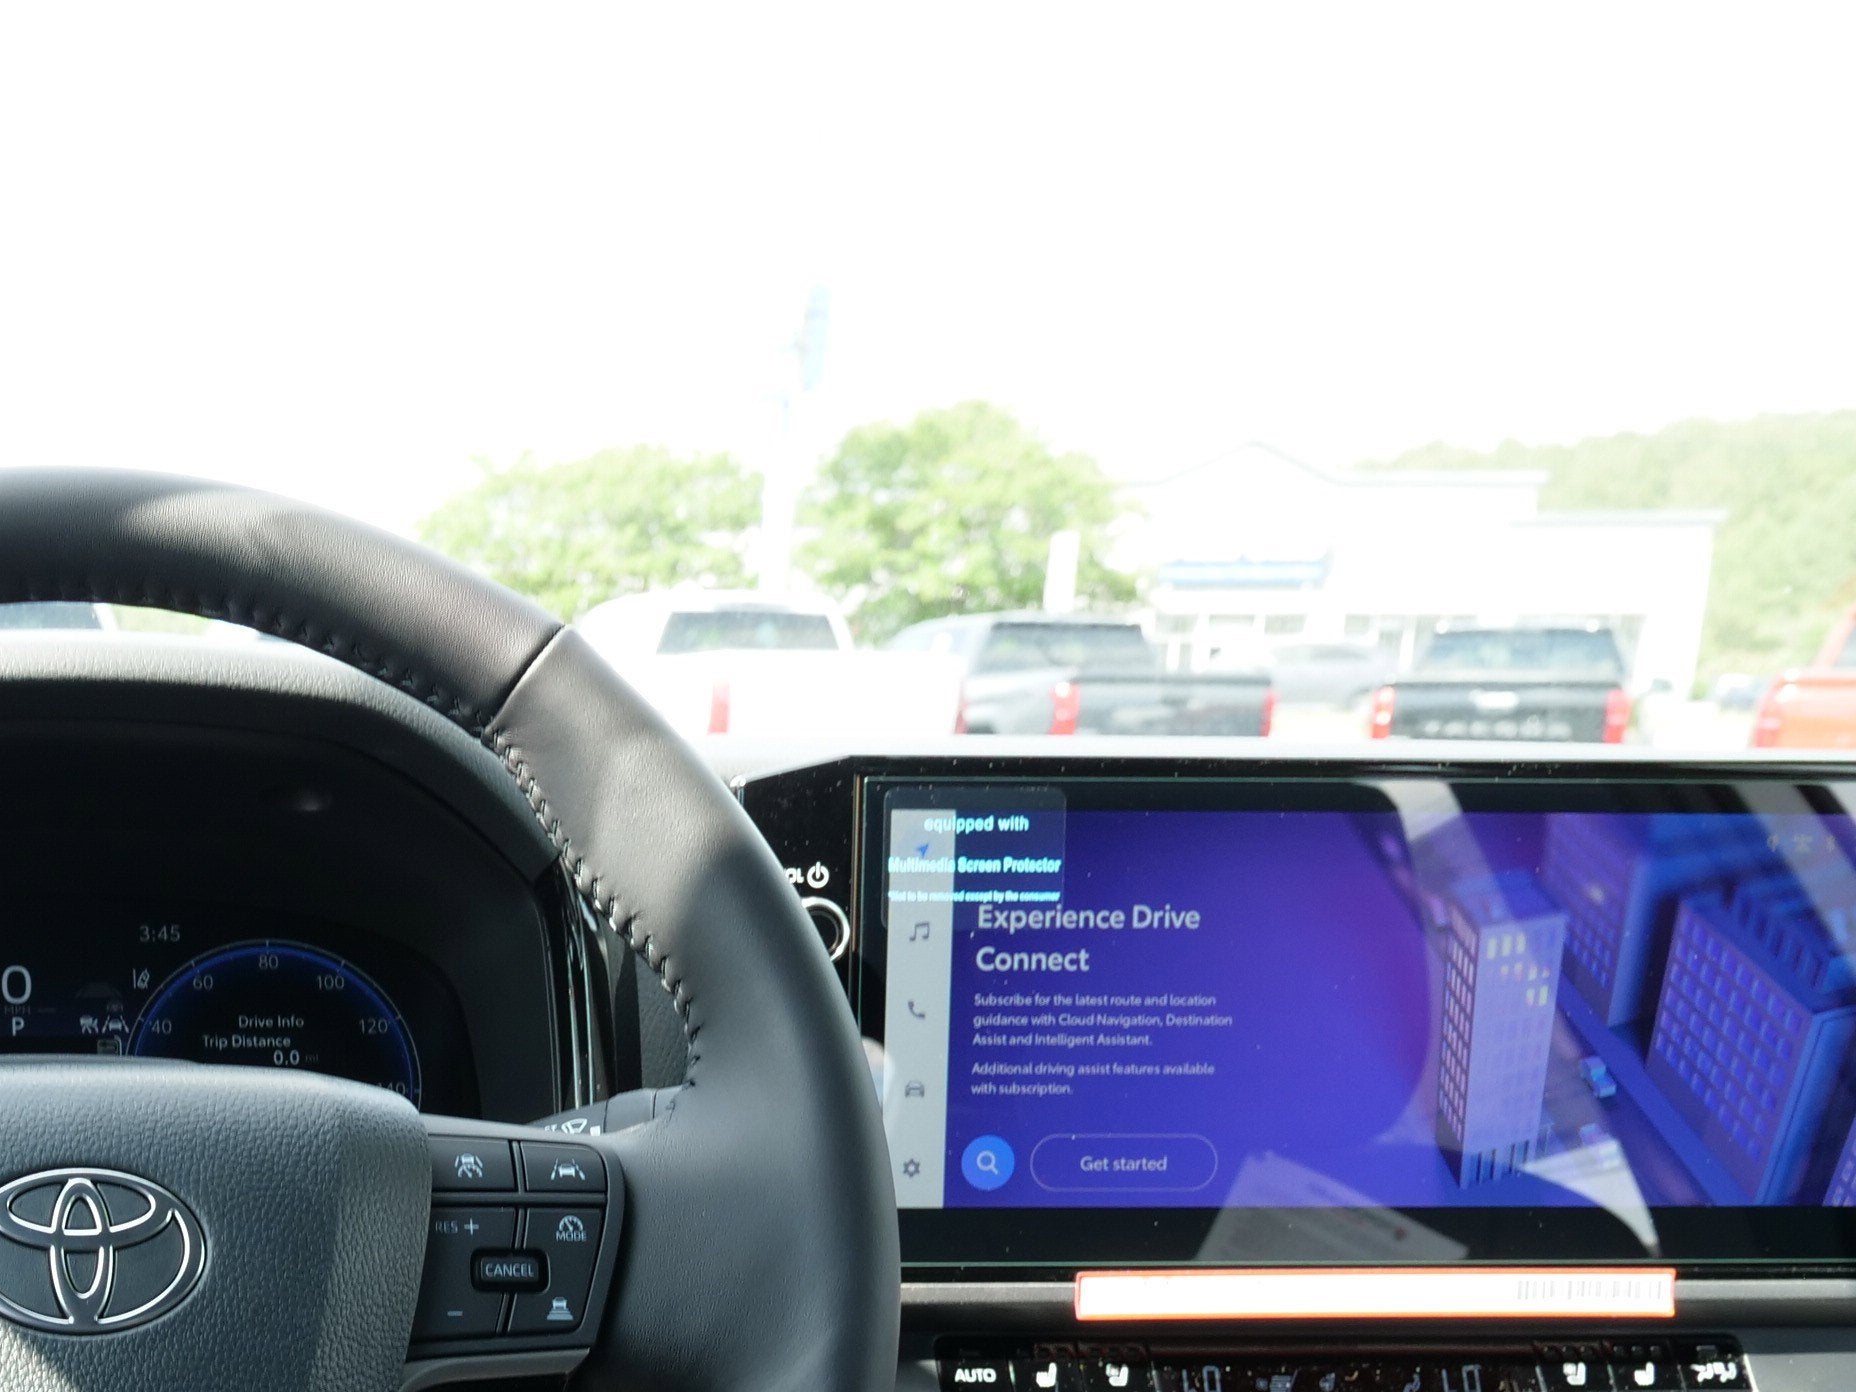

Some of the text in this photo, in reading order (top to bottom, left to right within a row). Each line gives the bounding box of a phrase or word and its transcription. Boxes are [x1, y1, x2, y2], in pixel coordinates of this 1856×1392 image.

[924, 815, 1029, 834] equipped with
[888, 857, 1062, 873] Multimedia Screen Protector
[977, 903, 1201, 935] Experience Drive
[139, 924, 181, 943] 3:45
[258, 954, 279, 970] 80
[975, 946, 1090, 971] Connect
[1, 964, 33, 1006] 0
[192, 975, 214, 991] 60
[315, 975, 345, 991] 100
[974, 992, 1216, 1007] Subscribe for the latest route and location
[11, 1016, 25, 1037] P
[151, 1018, 172, 1034] 40
[237, 1014, 305, 1029] Drive Info
[358, 1018, 389, 1034] 120
[973, 1013, 1232, 1030] guidance with Cloud Navigation, Destination
[202, 1035, 291, 1050] Trip Distance
[972, 1033, 1153, 1049] Assist and Intelligent Assistant.
[272, 1049, 301, 1066] 0.0
[971, 1062, 1216, 1080] Additional driving assist features available
[971, 1083, 1073, 1099] with subscription.
[1079, 1156, 1168, 1172] Get started
[555, 1230, 588, 1242] MODE
[484, 1262, 535, 1278] CANCEL
[954, 1367, 997, 1383] AUTO
